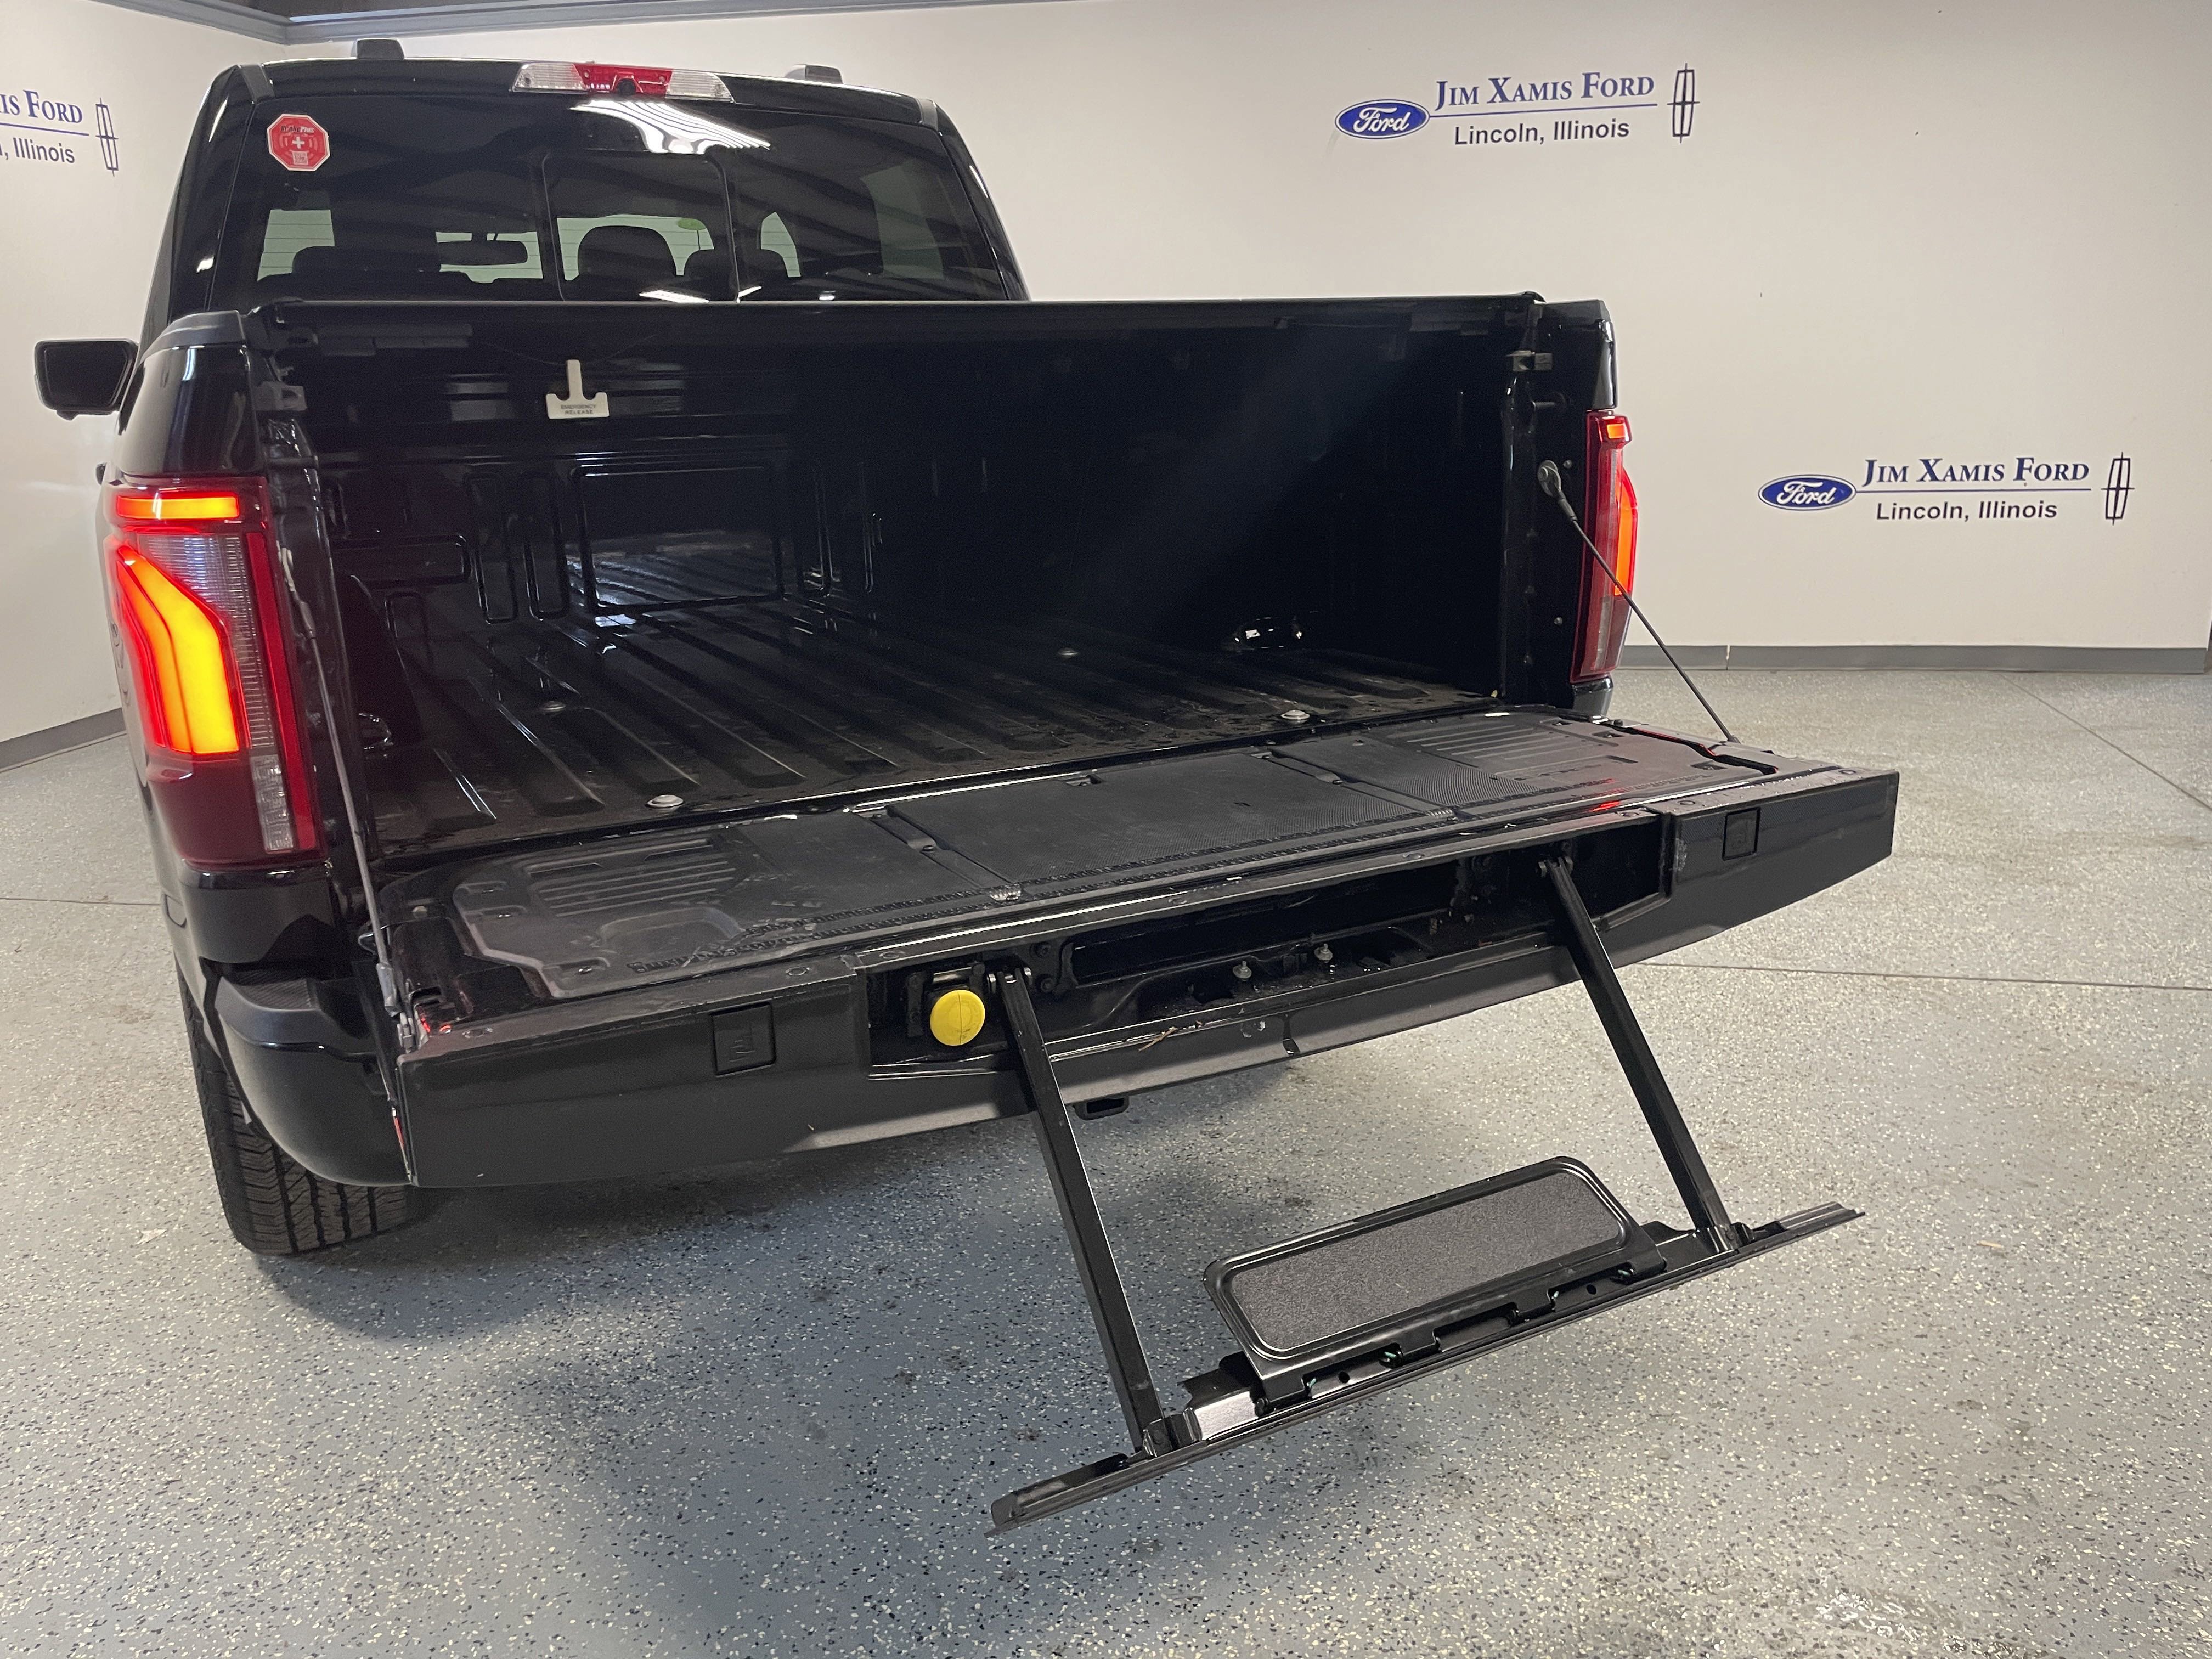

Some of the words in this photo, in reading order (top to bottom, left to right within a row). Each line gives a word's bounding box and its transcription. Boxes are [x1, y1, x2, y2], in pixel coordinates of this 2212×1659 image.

[1434, 80, 1480, 111] JIM
[1486, 76, 1572, 104] XAMIS
[1580, 71, 1655, 99] FORD
[22, 89, 83, 124] FORD
[1352, 106, 1412, 133] Ford
[1454, 123, 1545, 146] Lincoln,
[1553, 117, 1630, 141] Illinois
[13, 137, 76, 164] Illinois
[1861, 459, 1909, 487] JIM
[1915, 458, 2005, 483] XAMIS
[2012, 456, 2090, 482] FORD
[1776, 480, 1837, 505] Ford
[1876, 501, 1970, 523] Lincoln,
[1978, 499, 2058, 519] Illinois
